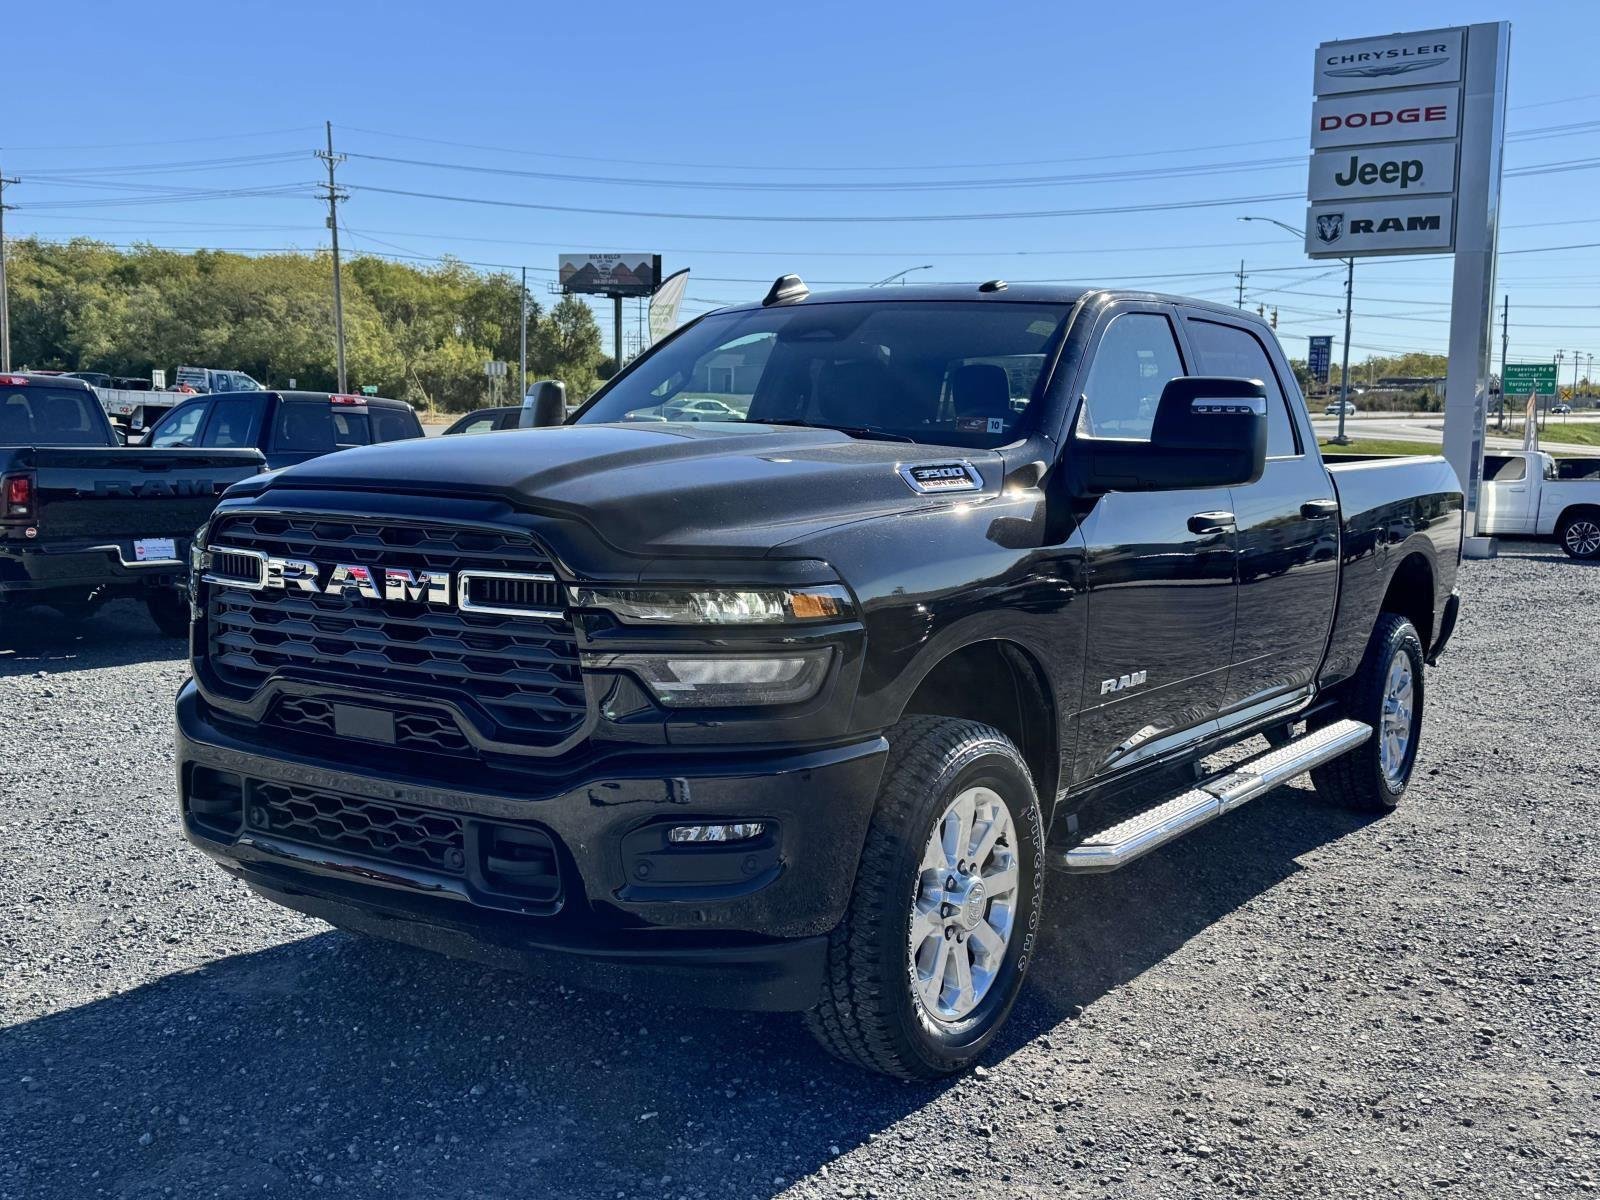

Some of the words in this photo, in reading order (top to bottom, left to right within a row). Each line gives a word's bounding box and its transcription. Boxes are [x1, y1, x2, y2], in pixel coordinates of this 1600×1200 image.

[1327, 44, 1447, 66] CHRYSLER
[1320, 106, 1447, 131] DODGE
[1335, 156, 1424, 189] Jeep
[1350, 216, 1440, 234] RAM
[991, 420, 1000, 430] 10
[915, 467, 965, 479] 3500
[94, 480, 215, 497] RAM
[268, 556, 451, 605] RAM
[1100, 670, 1147, 695] RAM
